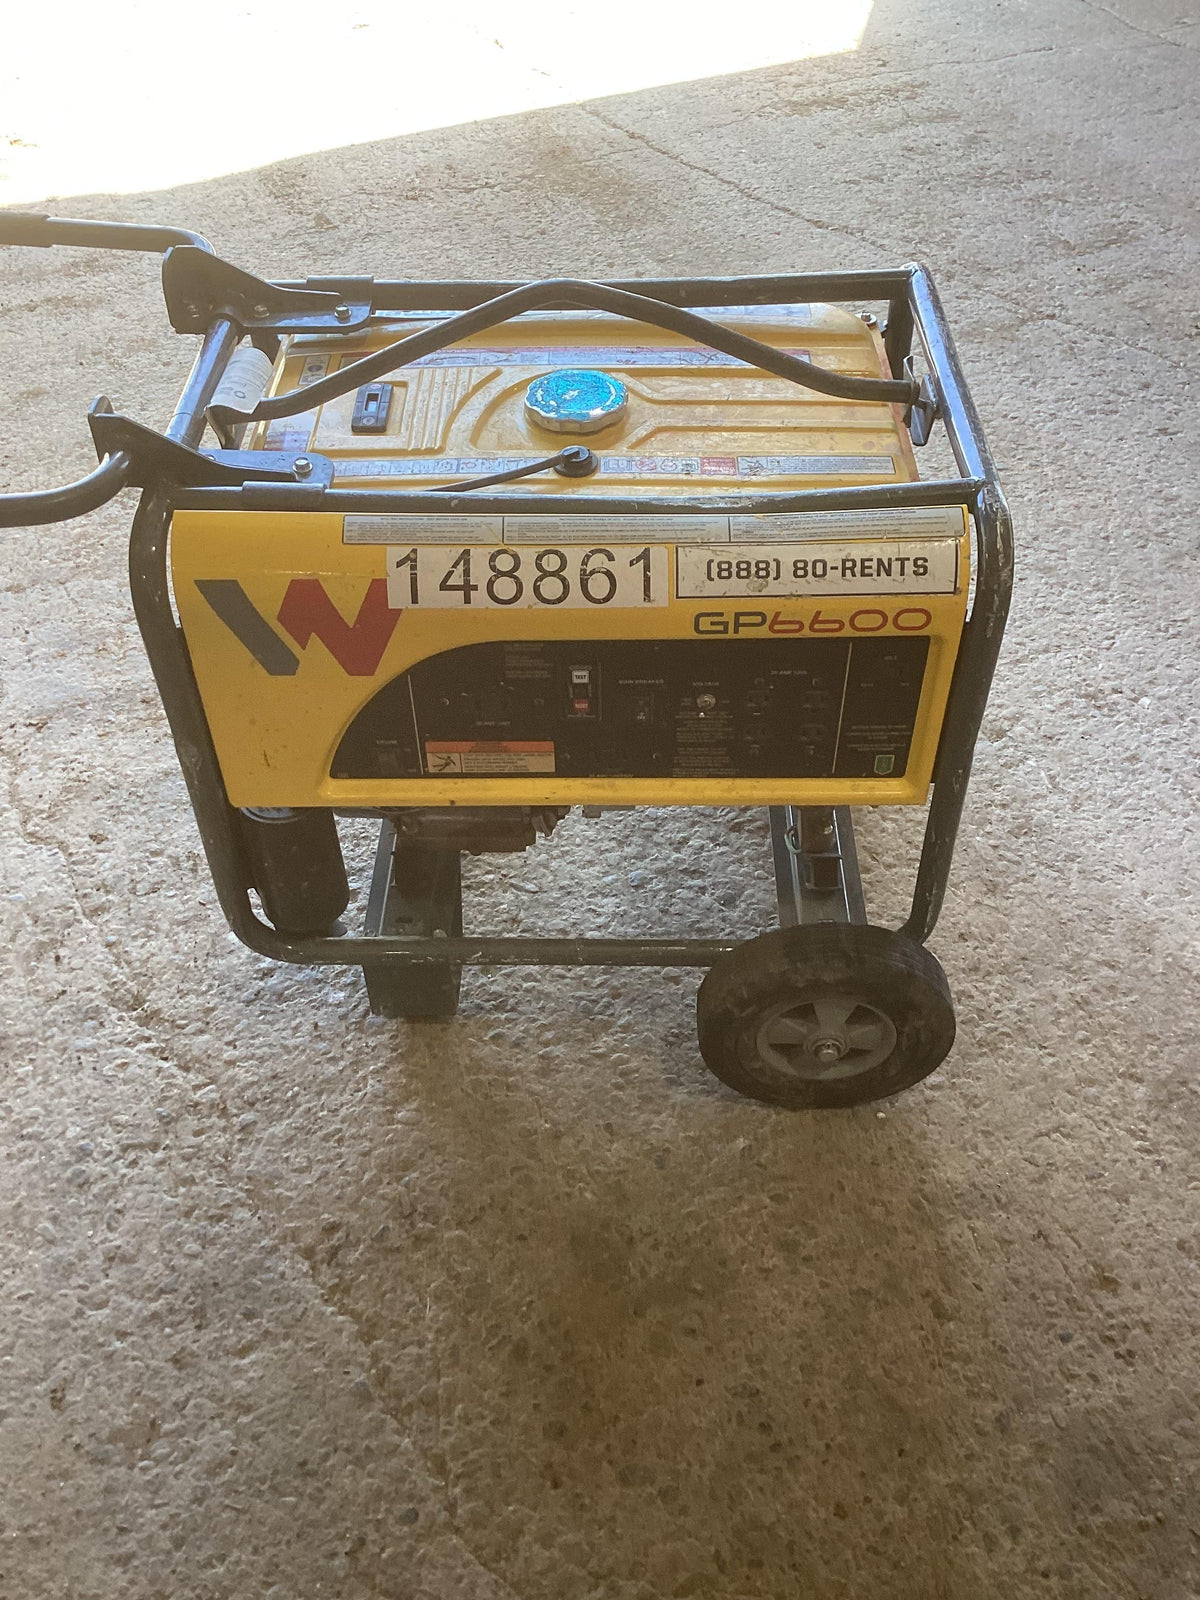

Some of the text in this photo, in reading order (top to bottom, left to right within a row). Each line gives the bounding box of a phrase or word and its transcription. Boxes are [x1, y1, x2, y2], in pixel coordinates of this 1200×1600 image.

[396, 548, 653, 605] 148861
[706, 556, 930, 582] (888) 80-RENTS
[693, 607, 933, 635] GP6600
